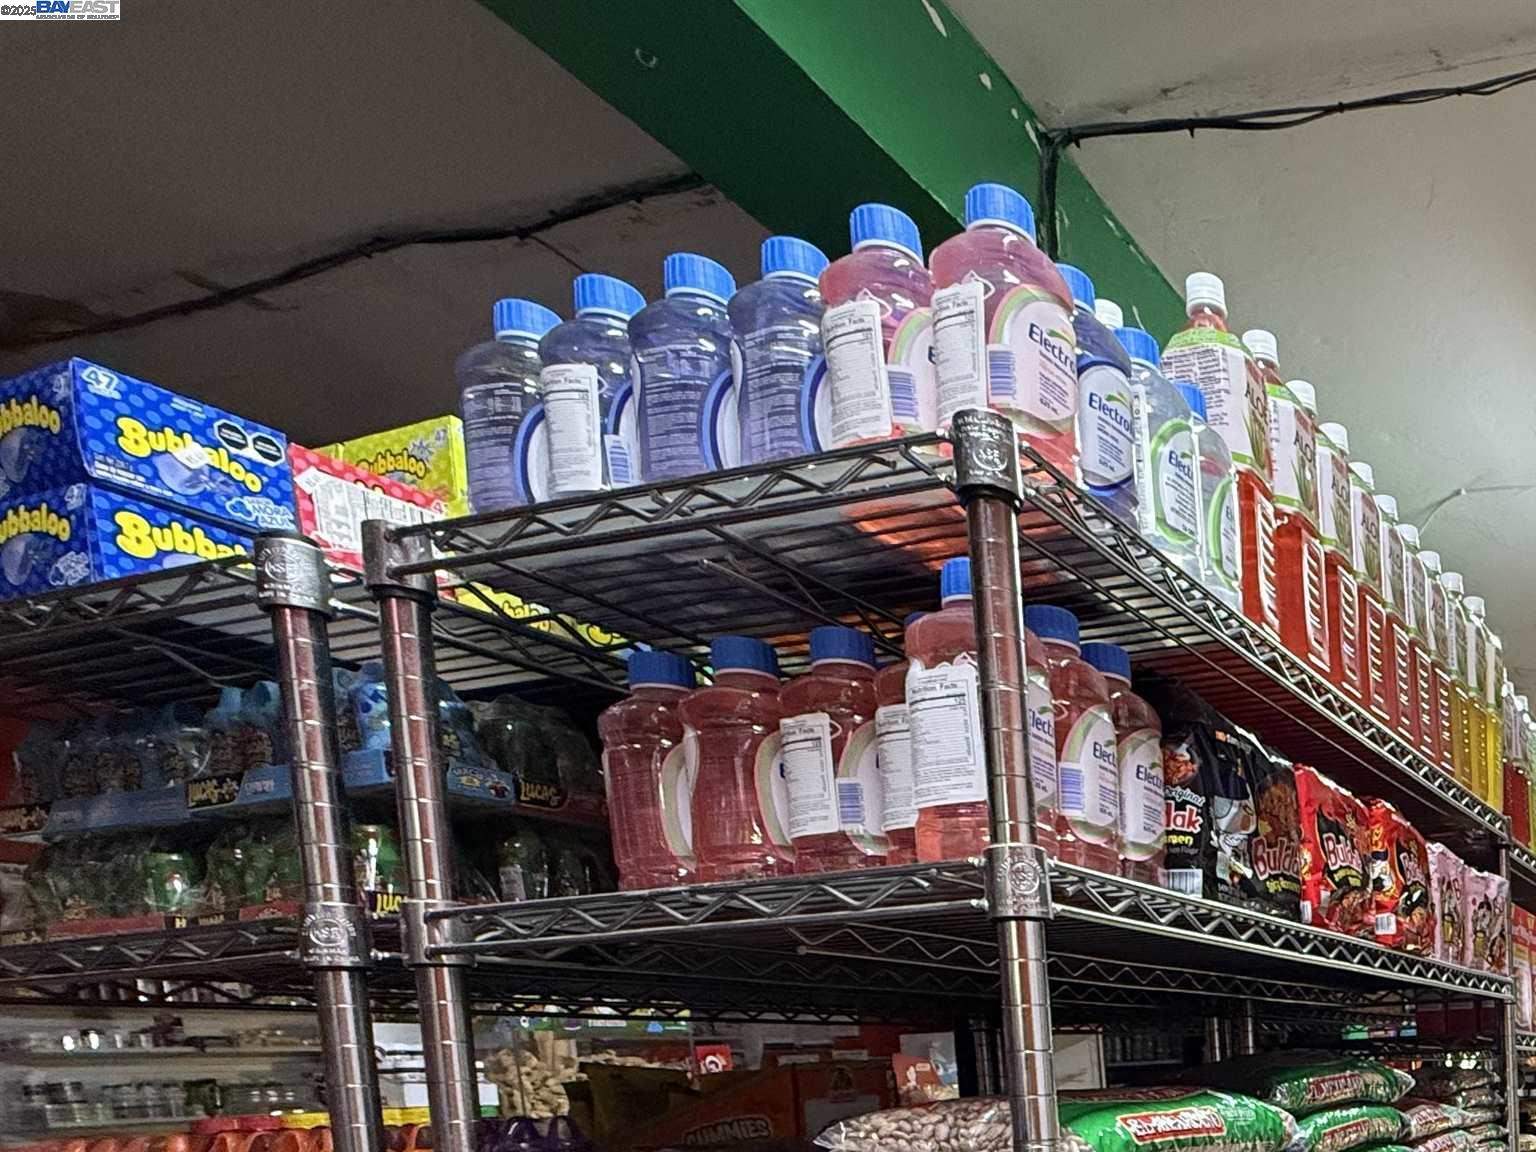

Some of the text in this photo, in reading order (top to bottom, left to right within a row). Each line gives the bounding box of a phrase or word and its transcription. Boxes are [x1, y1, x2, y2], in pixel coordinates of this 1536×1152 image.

[1029, 321, 1076, 372] Electro
[0, 395, 60, 434] bbaloo
[115, 416, 262, 493] Bubaloo
